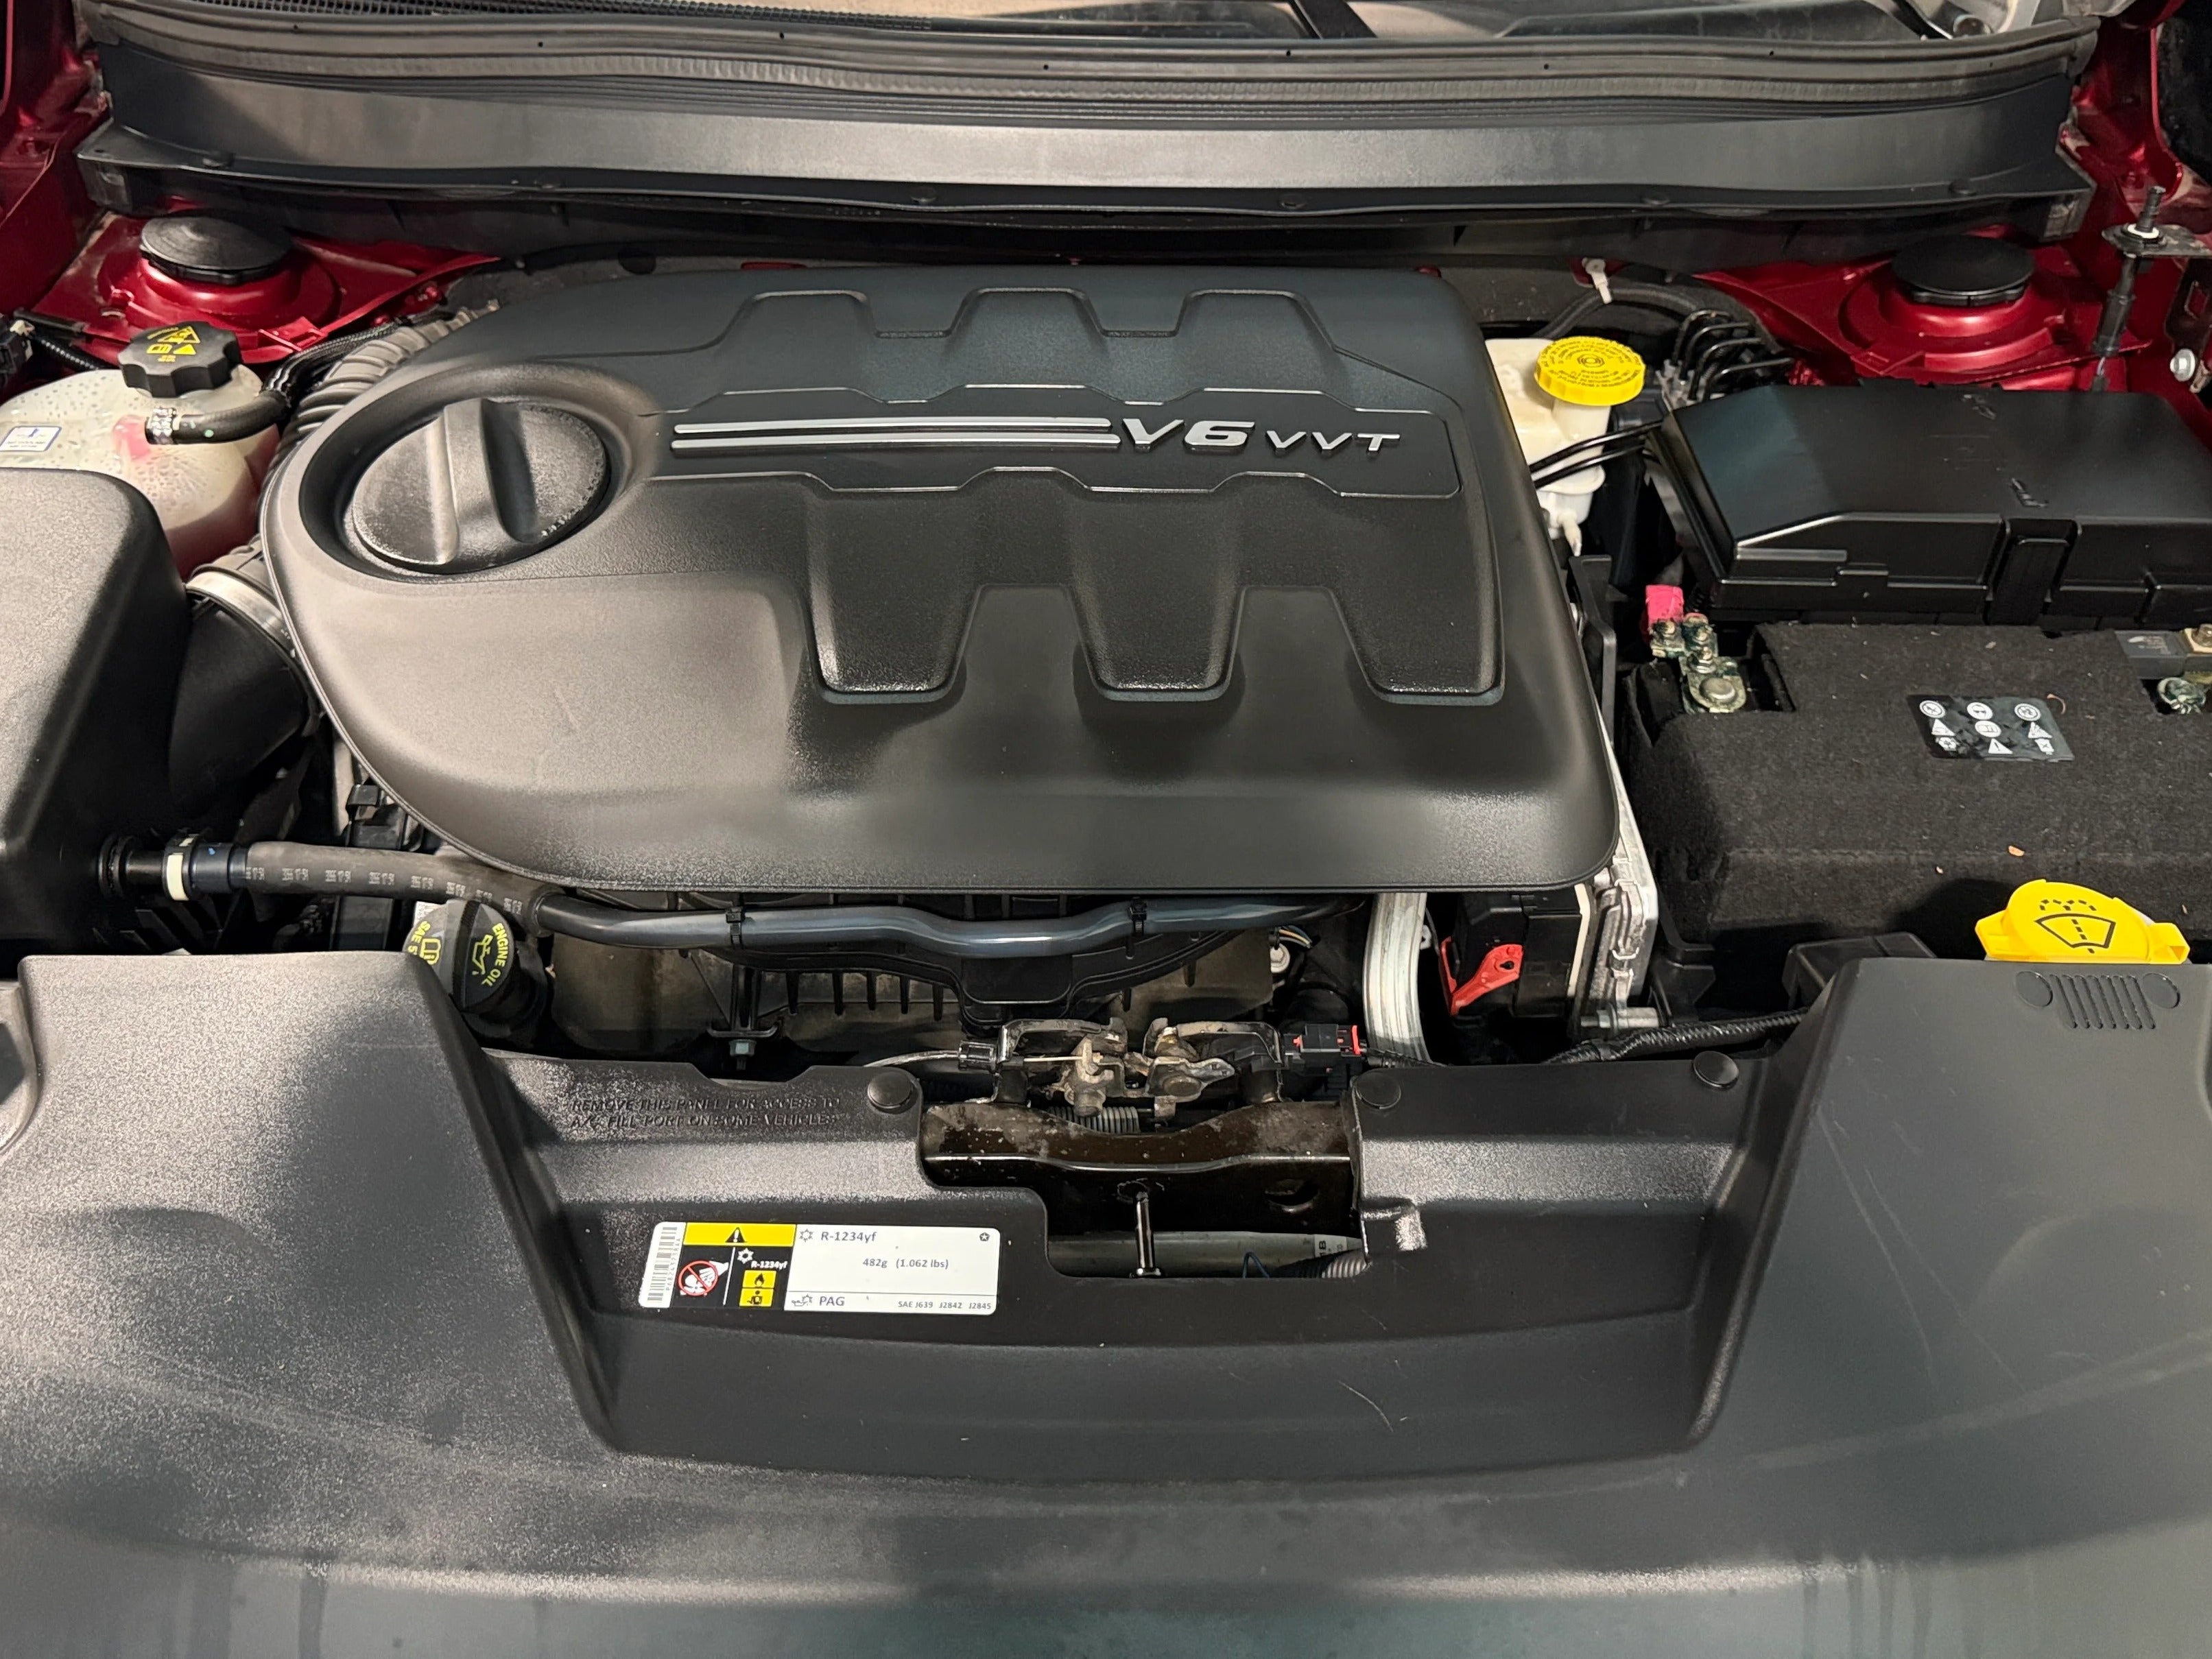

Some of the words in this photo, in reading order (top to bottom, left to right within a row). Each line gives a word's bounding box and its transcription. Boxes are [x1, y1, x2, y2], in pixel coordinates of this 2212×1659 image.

[1122, 418, 1255, 447] V6
[1266, 430, 1400, 451] VVT
[412, 920, 431, 944] SAE
[492, 922, 509, 968] ENGINE
[481, 968, 501, 988] OIL
[572, 1099, 634, 1110] REMOVE
[639, 1099, 671, 1110] THIS
[675, 1099, 718, 1110] PANEL
[726, 1099, 754, 1109] FOR
[607, 1114, 637, 1128] FILL
[643, 1114, 682, 1127] PORT
[687, 1114, 712, 1127] ON
[820, 1230, 878, 1244] R-1234yf
[750, 1260, 788, 1271] R-1234yf
[862, 1258, 888, 1269] 482g
[895, 1258, 928, 1269] (1.062
[930, 1258, 949, 1269] lbs)
[819, 1296, 846, 1306] PAG
[897, 1300, 913, 1309] SAE
[915, 1301, 933, 1309] J639
[938, 1301, 963, 1309] J2842
[968, 1302, 992, 1310] J2845
